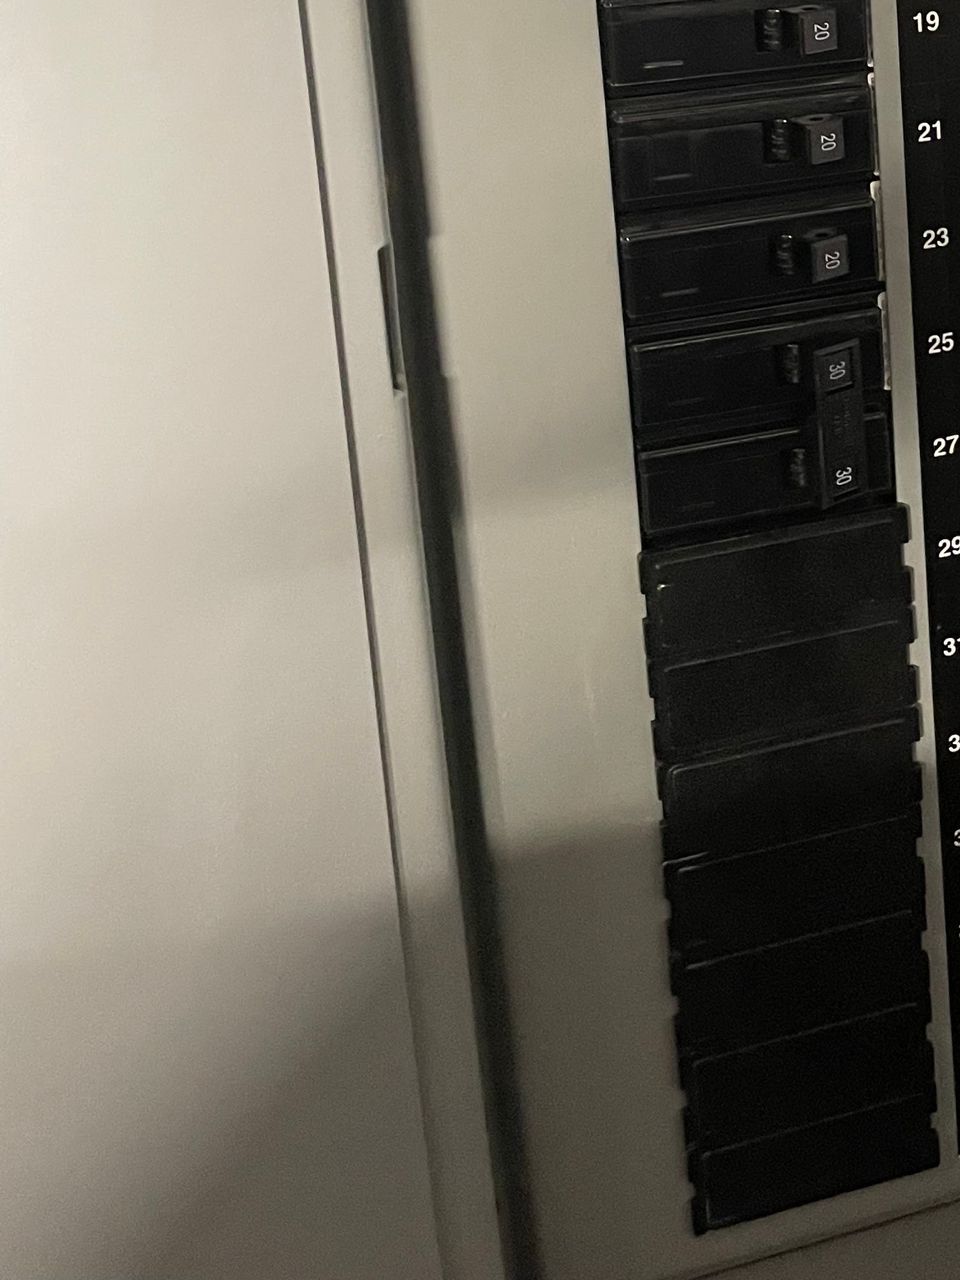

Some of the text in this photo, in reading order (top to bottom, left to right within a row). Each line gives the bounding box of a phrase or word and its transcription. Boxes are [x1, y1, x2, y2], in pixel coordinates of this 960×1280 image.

[813, 21, 831, 42] 20
[912, 10, 940, 33] 19
[820, 132, 837, 152] 20
[917, 120, 942, 143] 21
[922, 227, 950, 250] 23
[824, 251, 841, 270] 20
[927, 331, 955, 354] 25
[829, 360, 847, 381] 30
[933, 434, 960, 458] 27
[835, 466, 853, 487] 30
